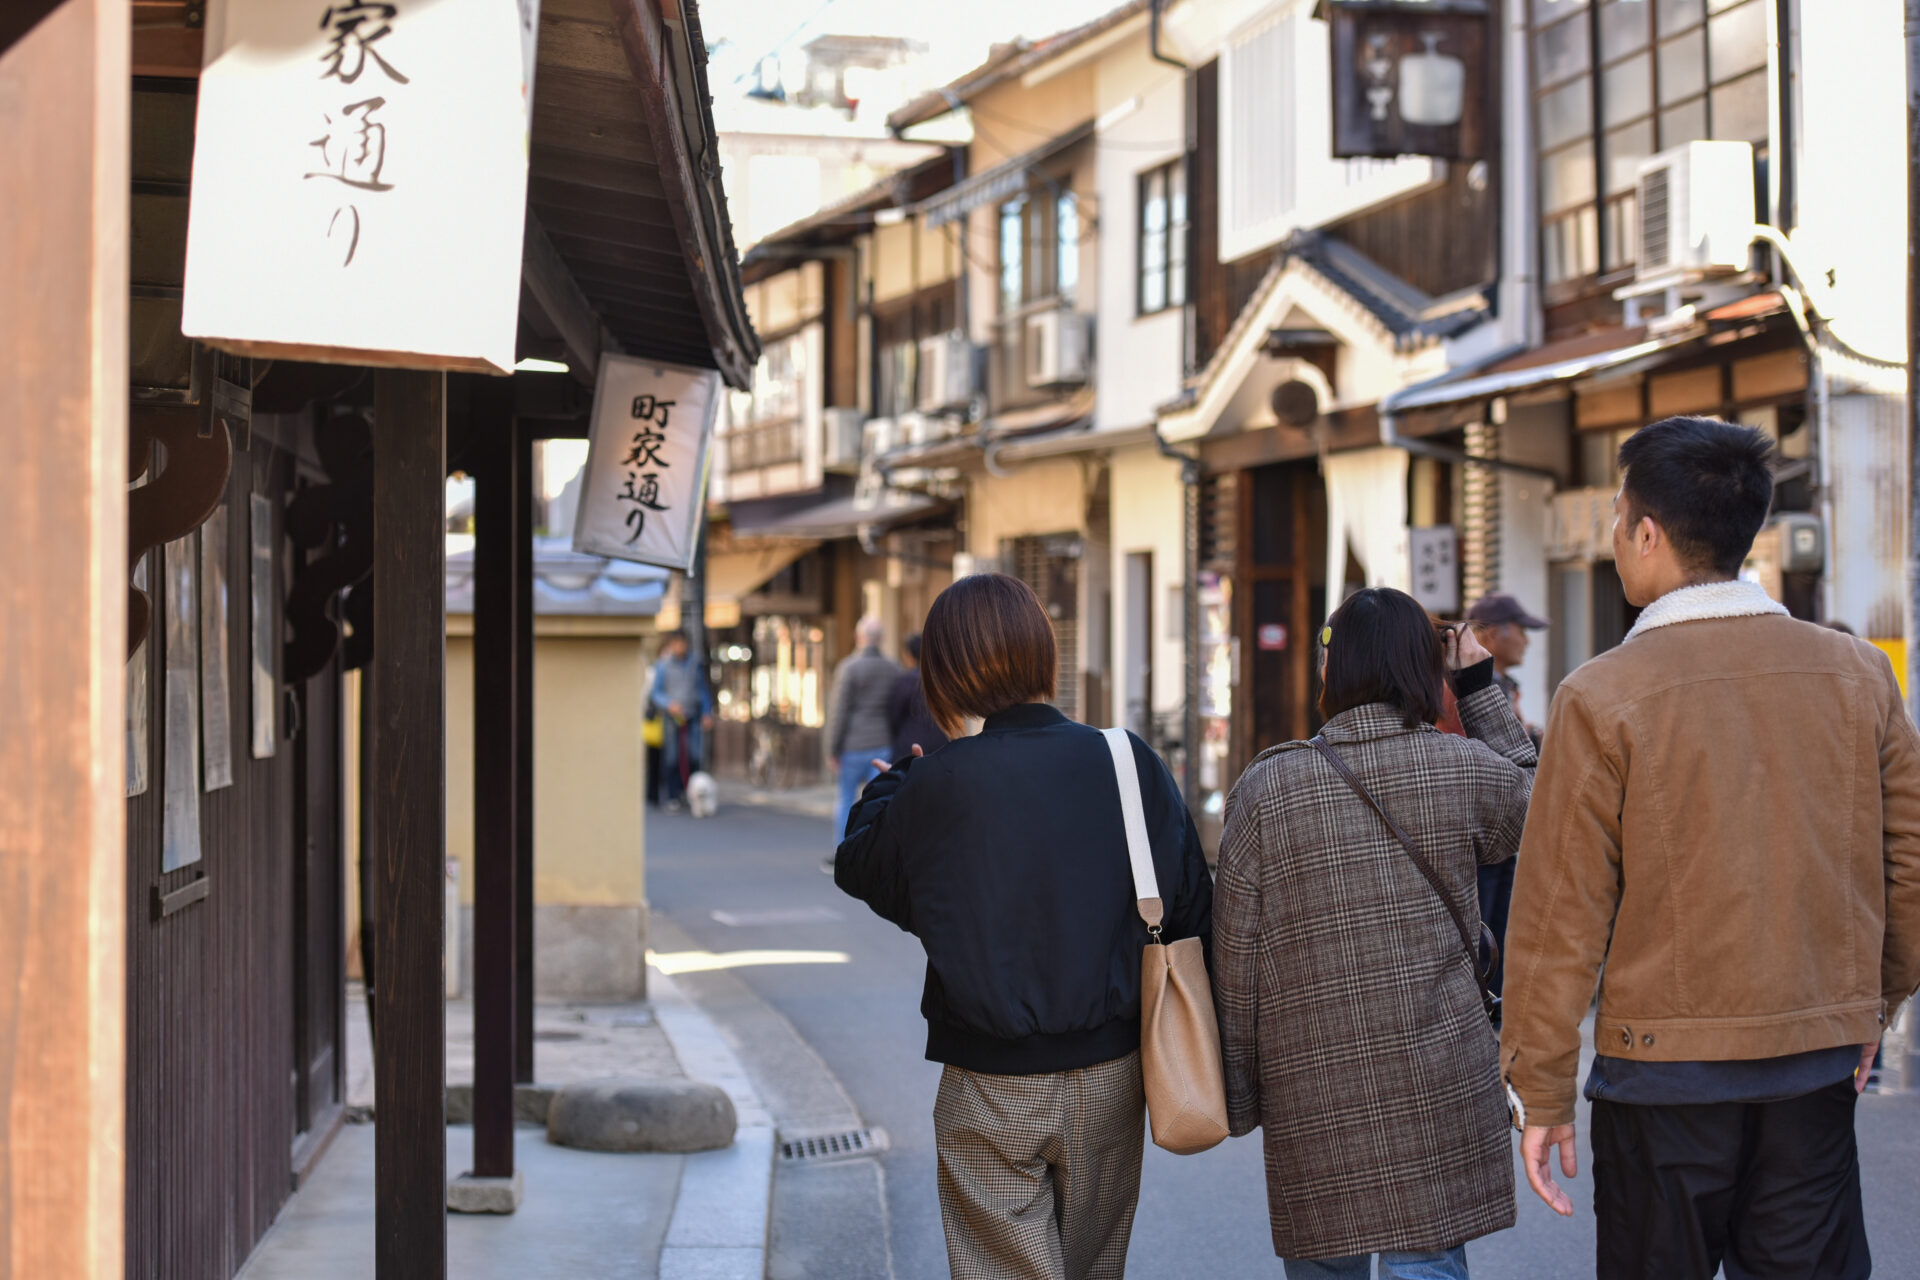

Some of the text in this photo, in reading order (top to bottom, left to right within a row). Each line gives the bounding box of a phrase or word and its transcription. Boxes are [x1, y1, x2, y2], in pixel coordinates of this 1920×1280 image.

[303, 0, 411, 268] 家通り
[616, 394, 676, 546] 町家通り
